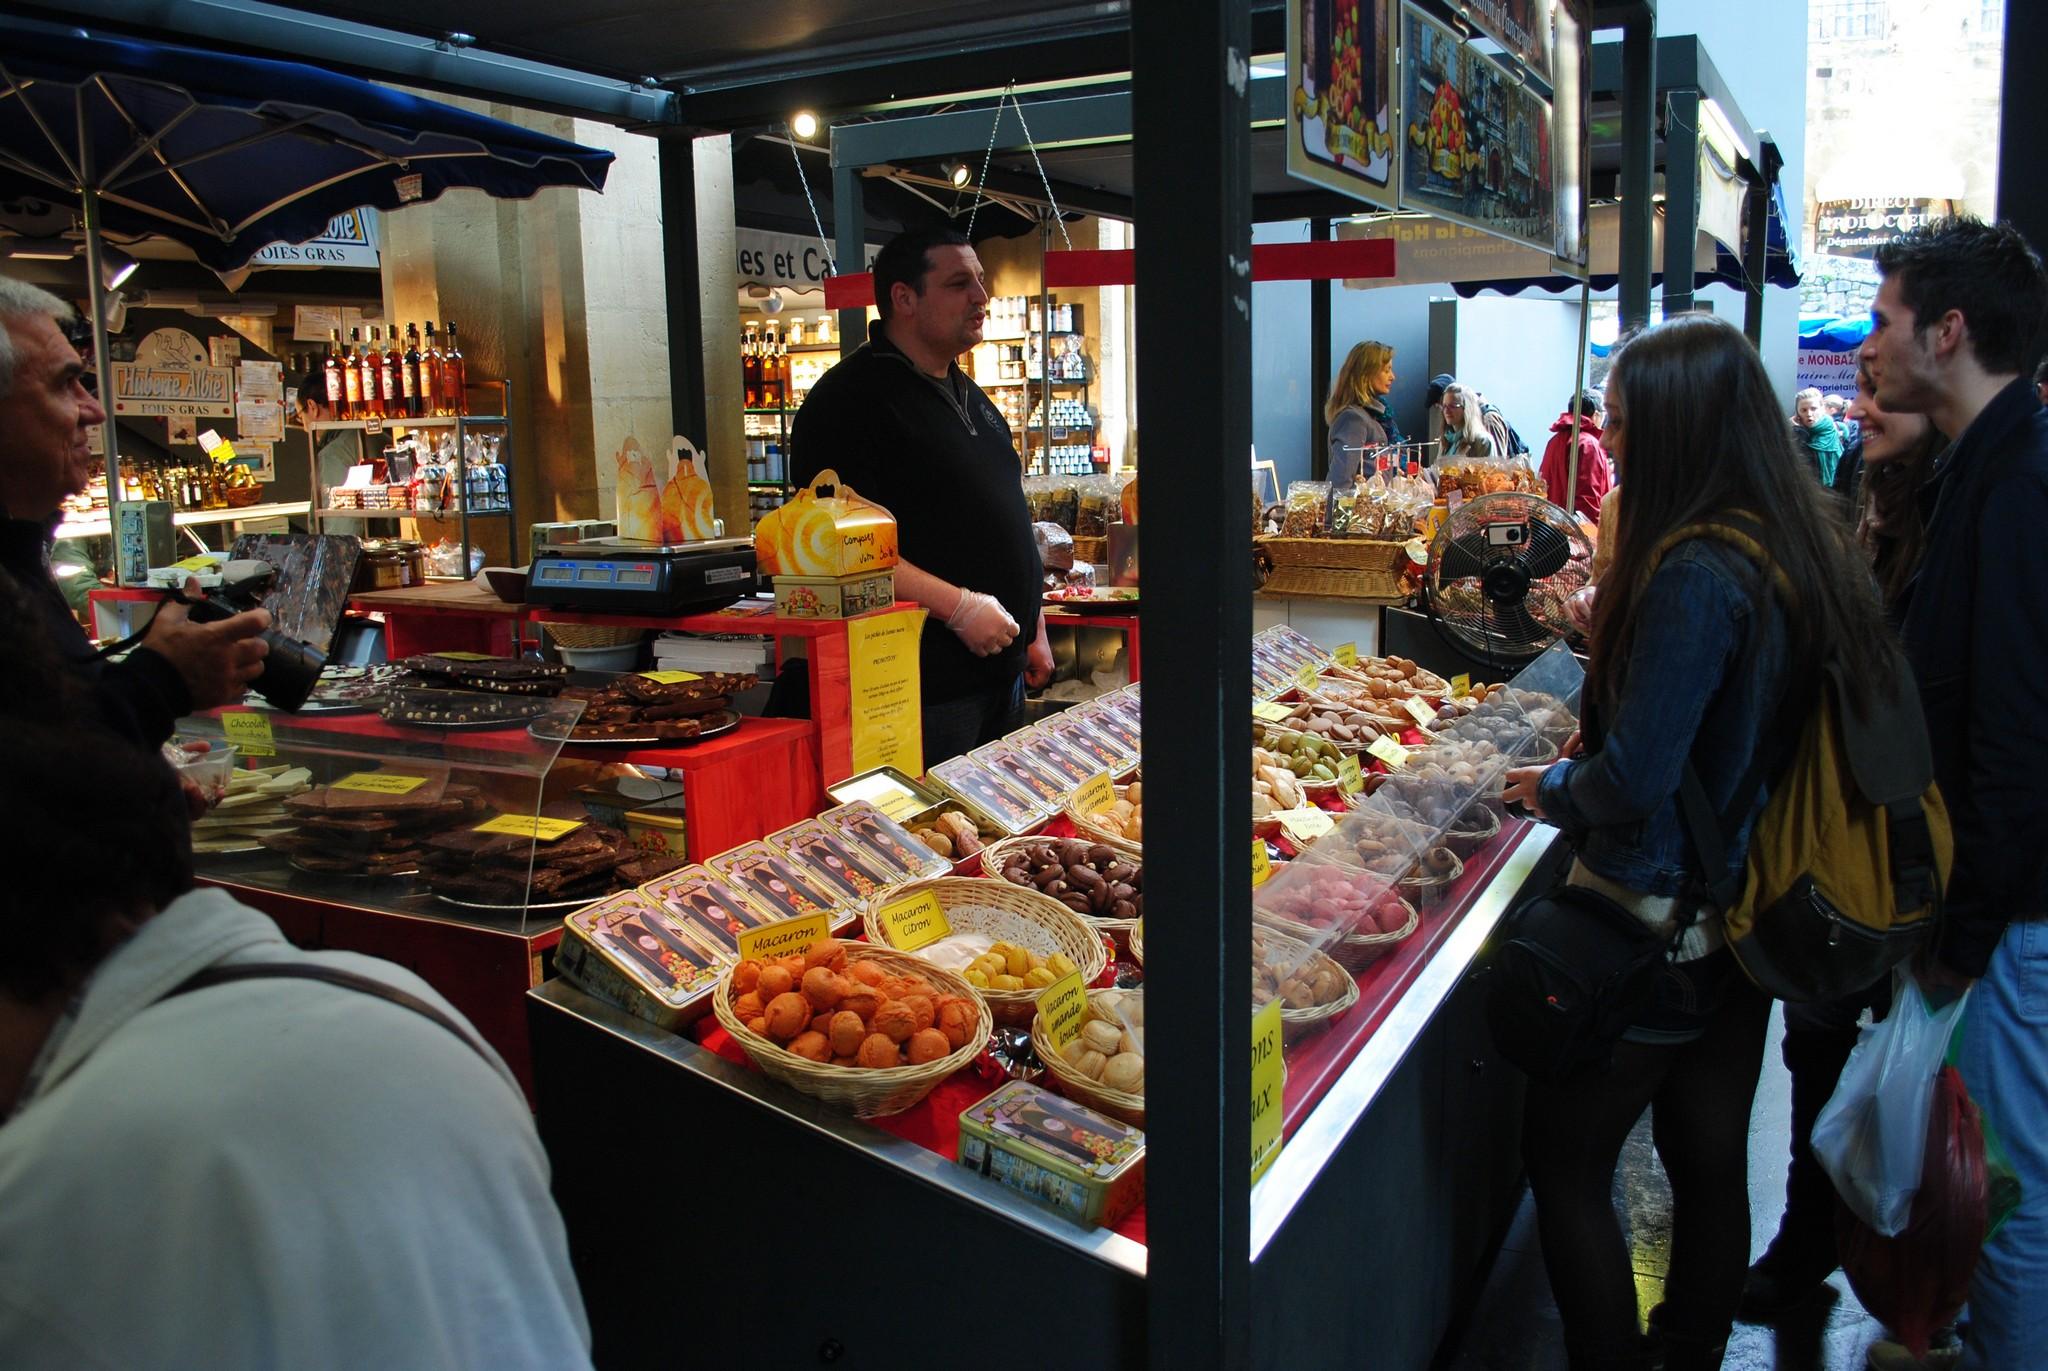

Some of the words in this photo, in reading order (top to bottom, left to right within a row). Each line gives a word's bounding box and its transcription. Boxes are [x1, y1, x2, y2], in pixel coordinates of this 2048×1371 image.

[252, 246, 300, 260] OIES
[305, 247, 346, 261] GRAS
[774, 250, 796, 279] et
[179, 404, 210, 415] GRAS
[230, 718, 267, 729] Chocolat
[891, 900, 932, 925] Macaron
[902, 916, 932, 938] Citron
[752, 926, 819, 954] Macaron
